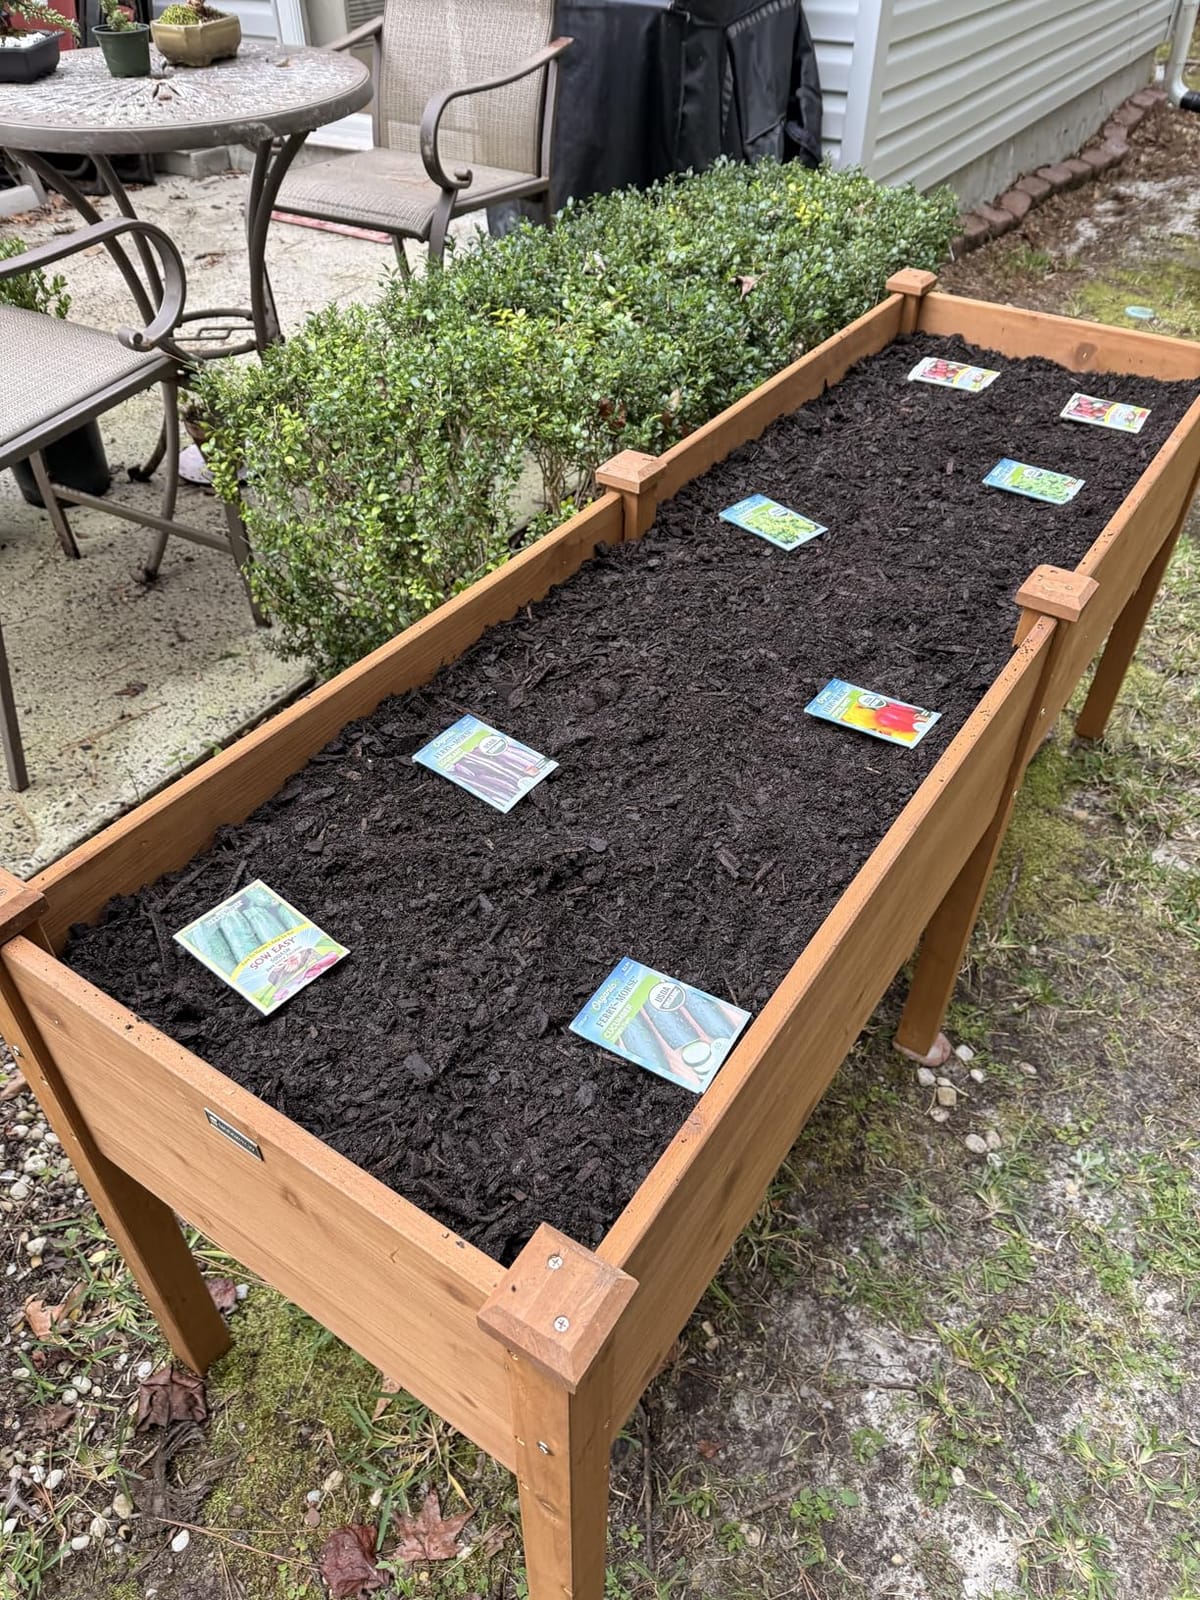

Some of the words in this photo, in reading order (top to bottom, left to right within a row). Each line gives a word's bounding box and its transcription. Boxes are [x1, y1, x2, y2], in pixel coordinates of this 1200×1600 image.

[250, 952, 272, 970] SOW
[272, 937, 295, 953] EASY
[592, 983, 617, 1011] Organic
[655, 986, 672, 1003] USDA
